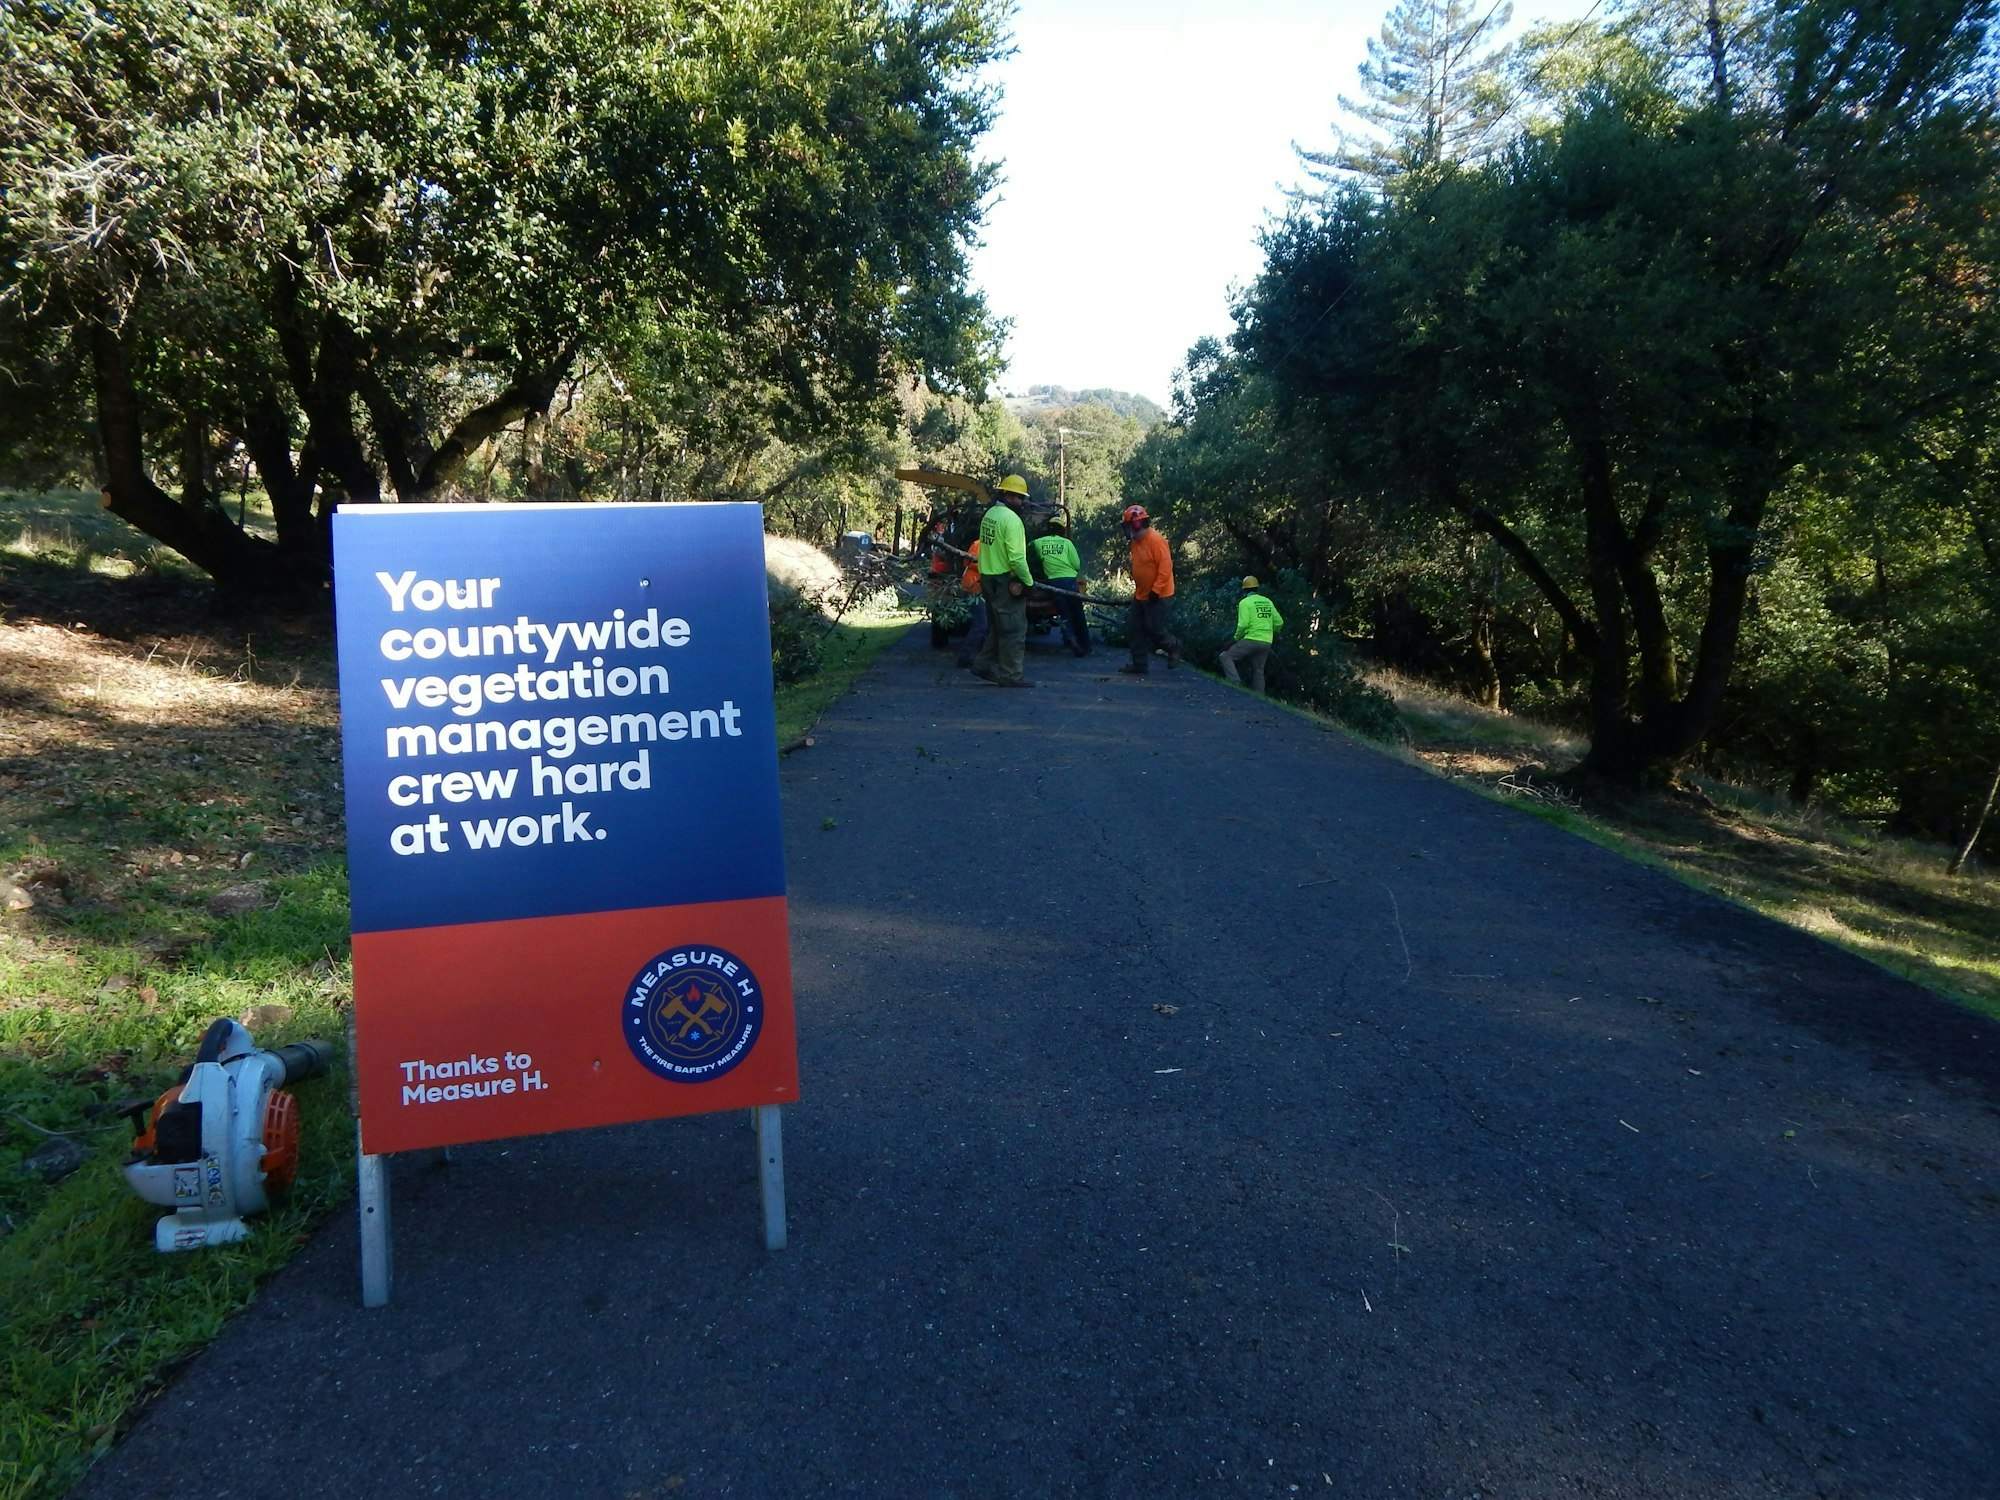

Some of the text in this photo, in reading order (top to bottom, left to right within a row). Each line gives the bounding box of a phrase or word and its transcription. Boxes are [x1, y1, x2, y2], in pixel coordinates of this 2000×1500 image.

[376, 571, 500, 611] Your
[380, 608, 691, 663] countywide
[381, 656, 669, 716] vegetation
[386, 701, 742, 758] management
[388, 749, 651, 806] crew hard
[390, 802, 607, 855] at work.
[631, 951, 754, 1007] MEASURE H
[400, 1051, 532, 1082] Thanks to
[638, 1024, 752, 1074] THE FIRE SAFETY MEASURE
[402, 1070, 549, 1106] Measure H.
